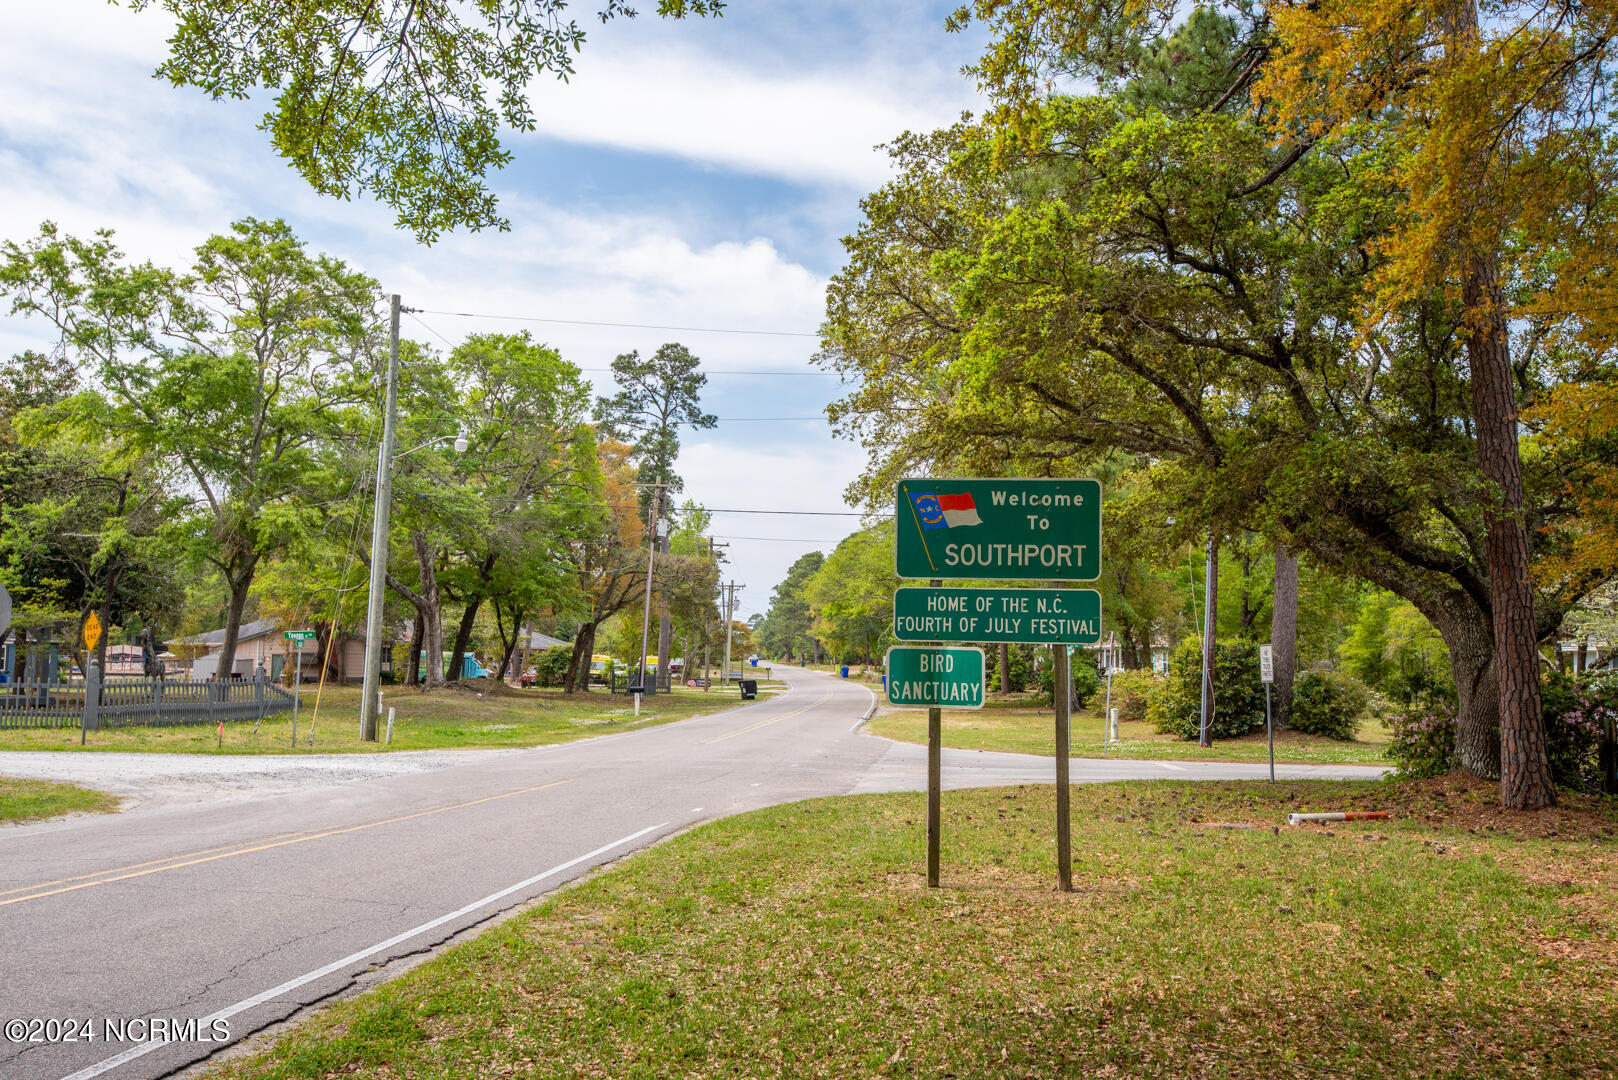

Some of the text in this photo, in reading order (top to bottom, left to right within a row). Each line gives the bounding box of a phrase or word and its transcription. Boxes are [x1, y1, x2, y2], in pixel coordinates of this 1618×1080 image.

[991, 491, 1084, 506] Welcome
[1027, 515, 1050, 530] To
[945, 544, 1087, 567] SOUTHPORT
[927, 596, 1068, 614] HOME OF THE N.C.
[86, 623, 99, 631] DEAD
[897, 616, 1098, 635] FOURTH OF JULY FESTIVAL
[920, 654, 954, 673] BIRD
[891, 681, 980, 701] SANCTUARY
